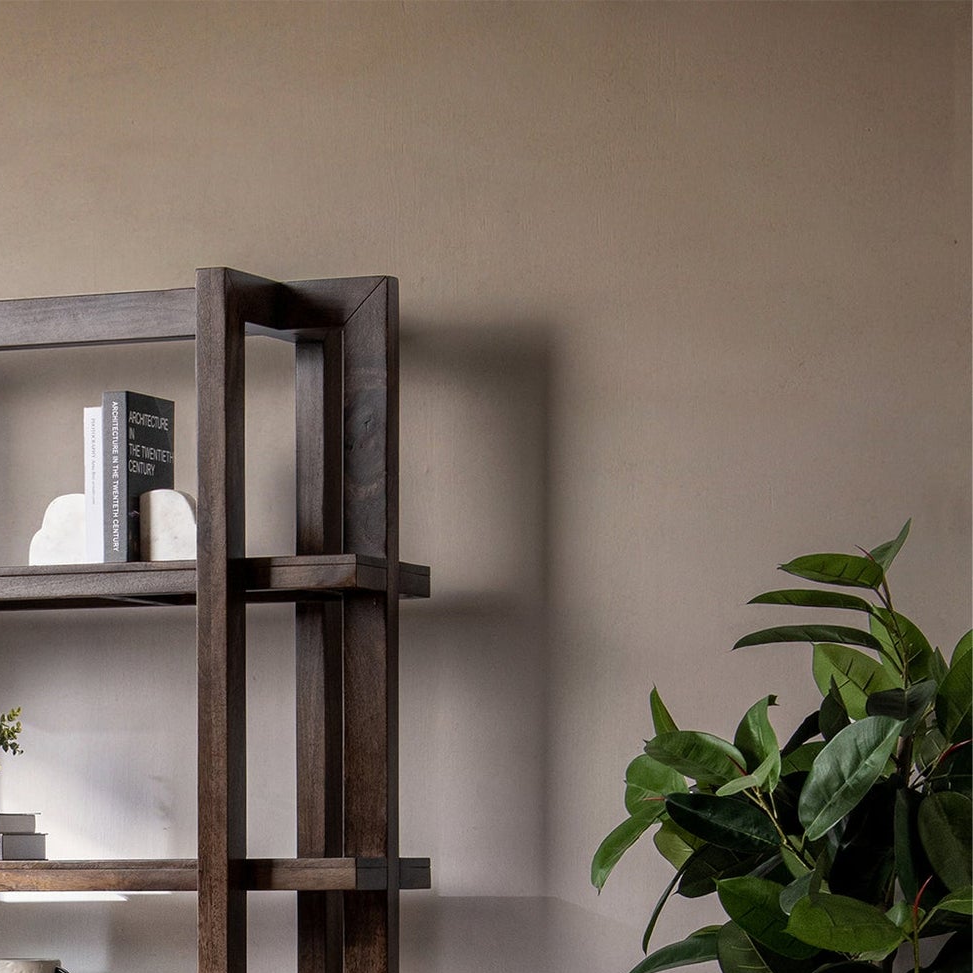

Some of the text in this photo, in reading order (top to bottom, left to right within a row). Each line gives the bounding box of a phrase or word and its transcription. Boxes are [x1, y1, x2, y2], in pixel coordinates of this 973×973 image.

[111, 401, 119, 454] ARCHITECTURE
[128, 411, 169, 431] ARCHITECTURE
[128, 427, 135, 440] IN
[111, 456, 119, 464] IN
[128, 443, 173, 463] THE TWENTIETH
[111, 464, 119, 479] THE
[128, 459, 156, 476] CENTURY
[111, 519, 119, 552] CENTURY
